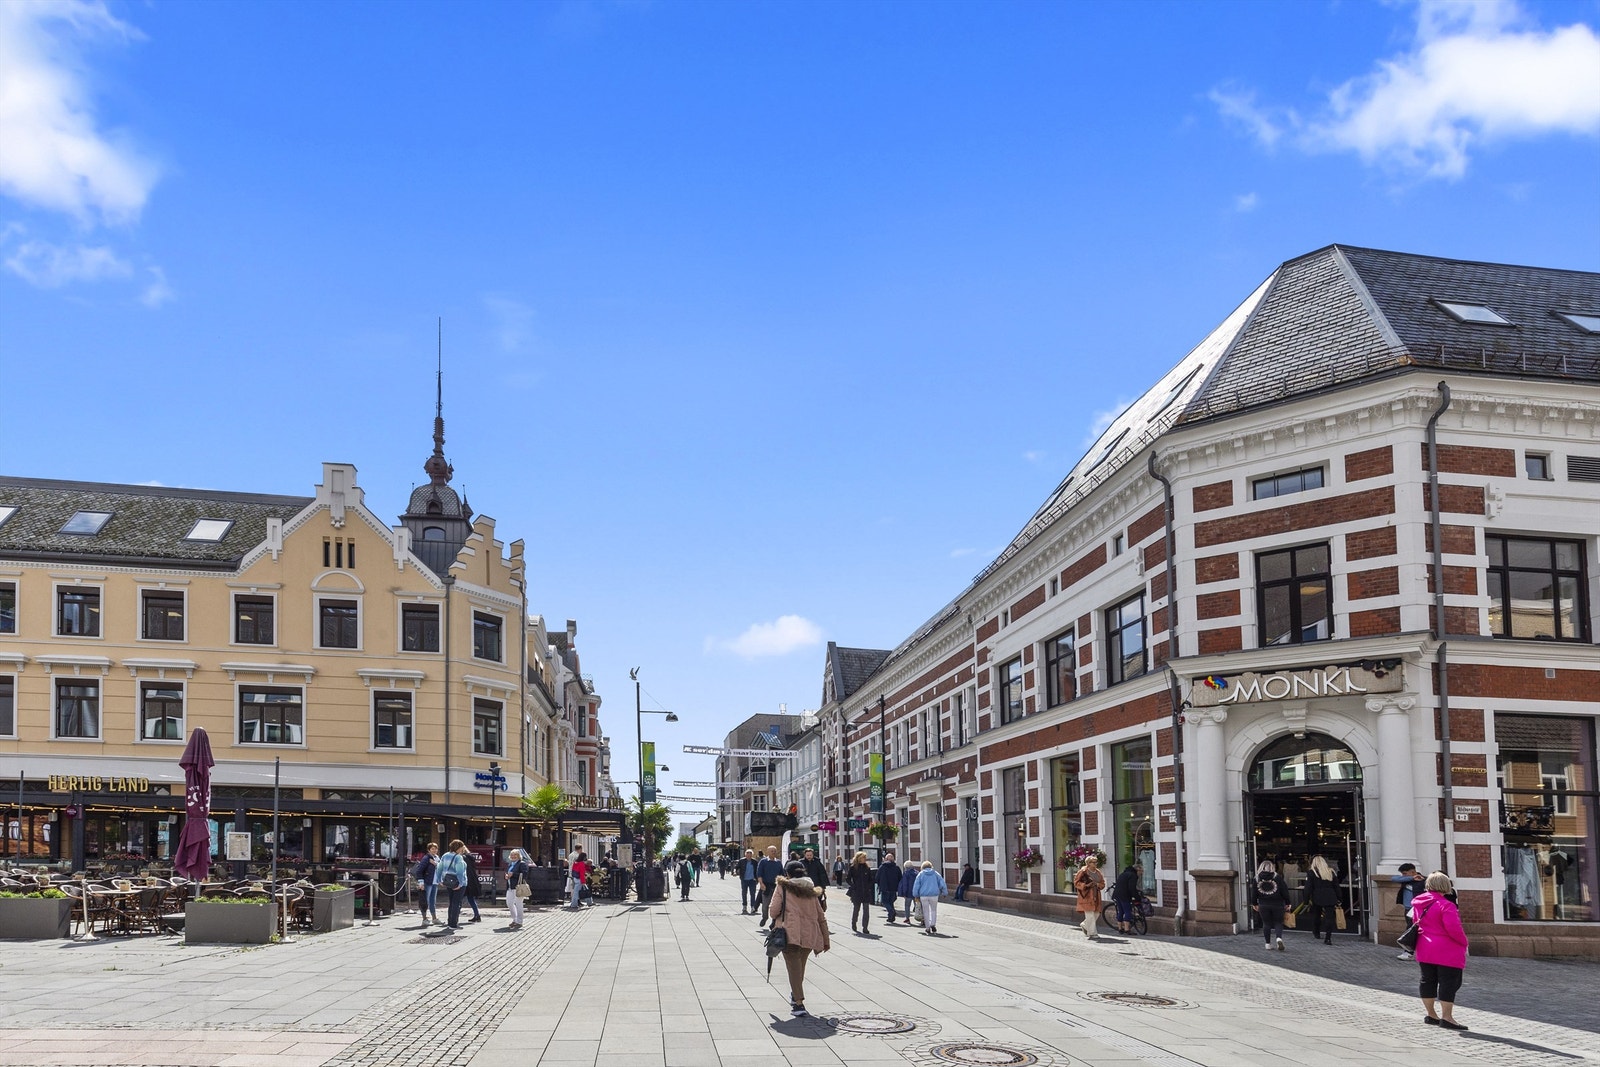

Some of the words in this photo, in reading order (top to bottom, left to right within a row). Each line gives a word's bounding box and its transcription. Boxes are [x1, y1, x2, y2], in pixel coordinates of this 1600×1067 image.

[1218, 667, 1367, 704] MONKI
[48, 774, 102, 791] HERLIG
[109, 776, 150, 793] LAND
[965, 807, 978, 823] DNB
[851, 820, 866, 828] DNB
